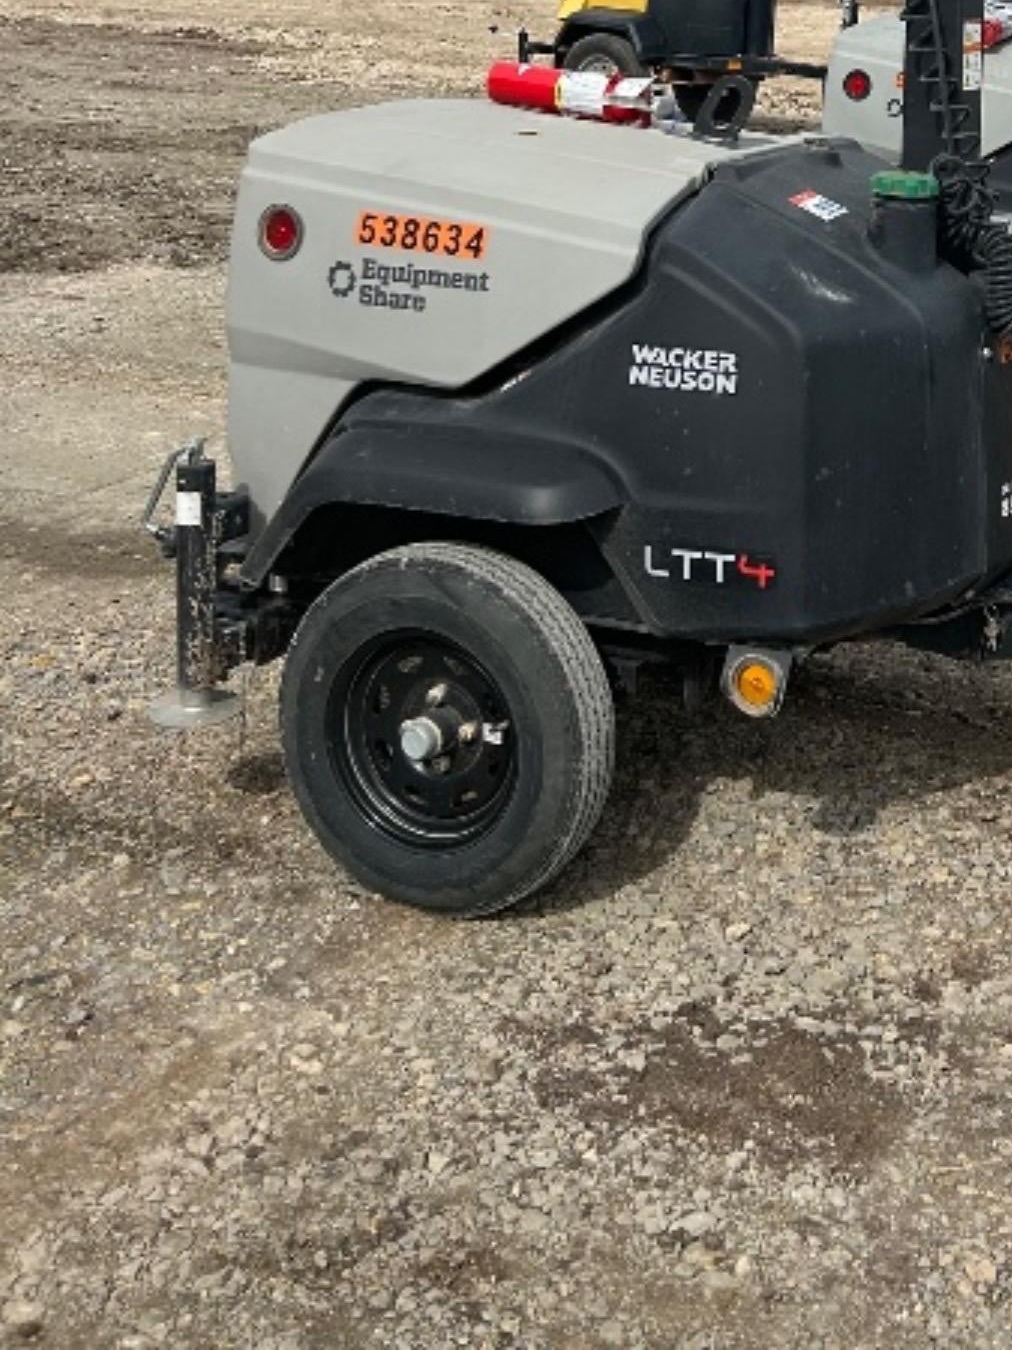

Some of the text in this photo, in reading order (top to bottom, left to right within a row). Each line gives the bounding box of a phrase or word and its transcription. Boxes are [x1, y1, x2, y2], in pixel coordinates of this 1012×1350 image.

[359, 213, 483, 258] 538634
[362, 257, 490, 292] Equipment
[359, 284, 427, 312] Share
[631, 343, 738, 373] WACKER
[628, 365, 738, 394] NEUSON
[644, 545, 775, 588] LTT4
